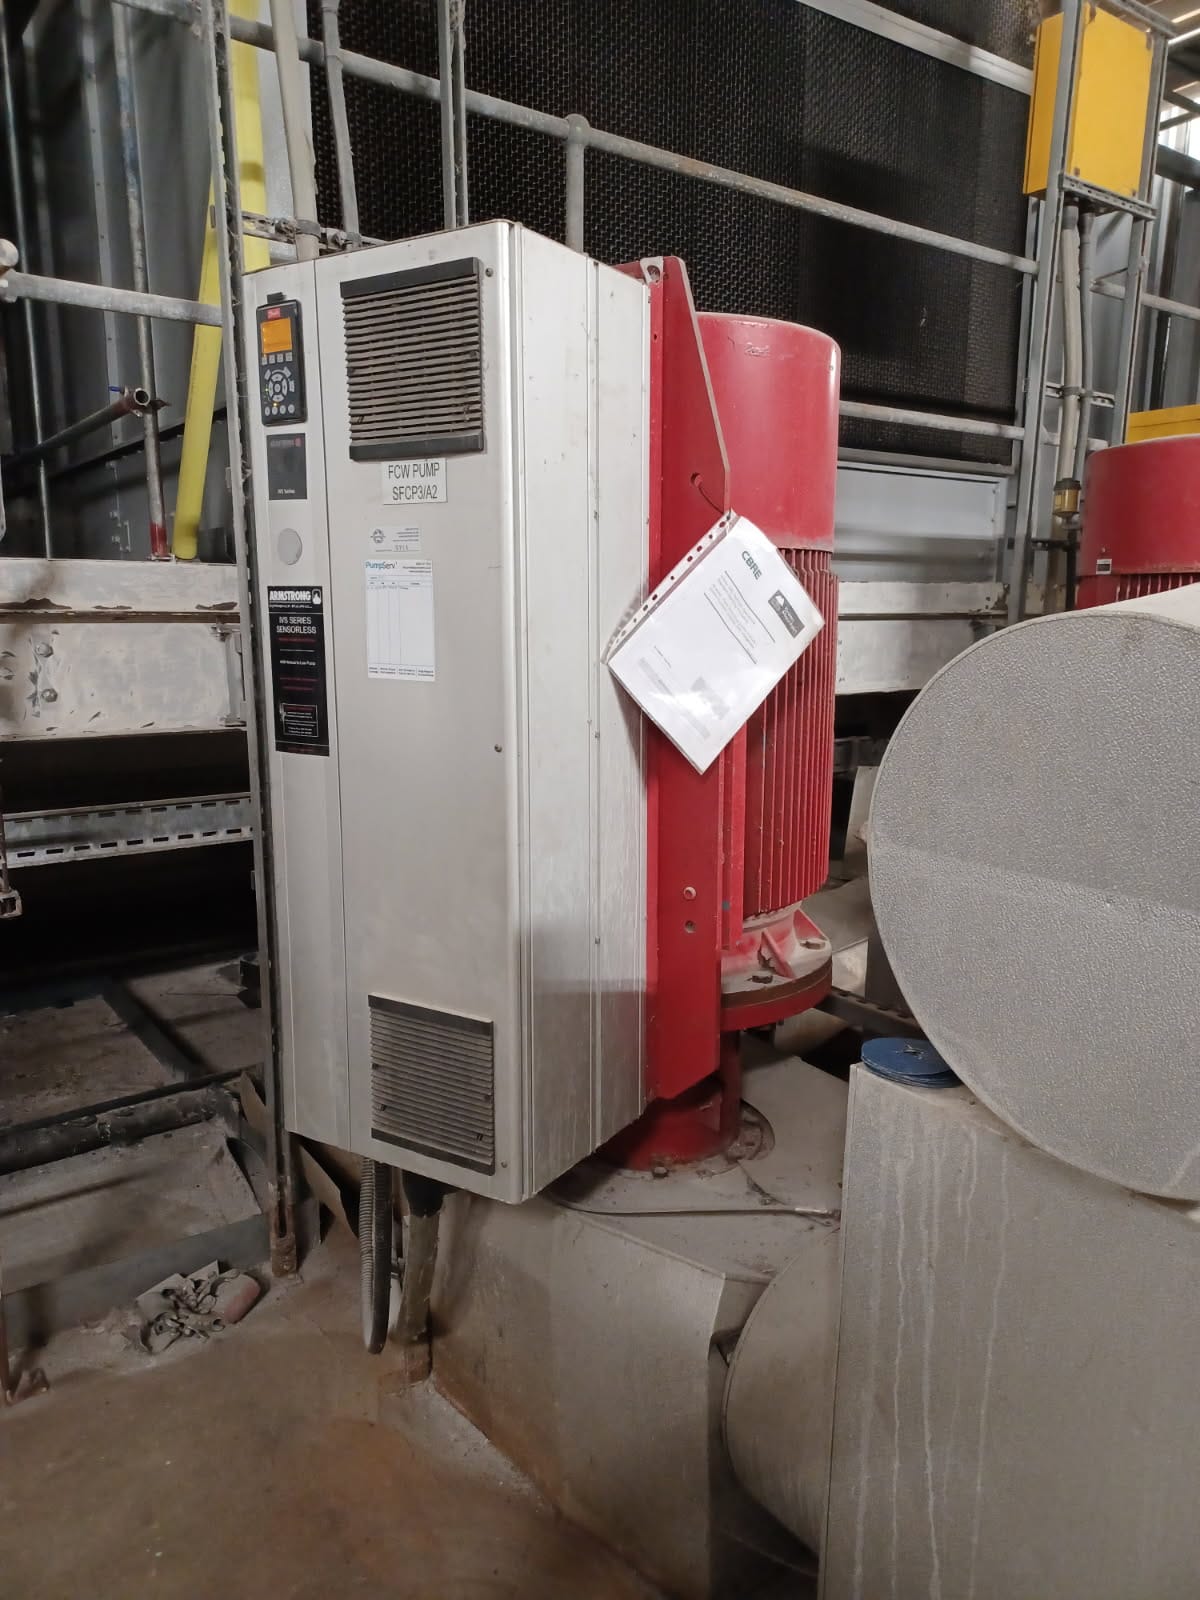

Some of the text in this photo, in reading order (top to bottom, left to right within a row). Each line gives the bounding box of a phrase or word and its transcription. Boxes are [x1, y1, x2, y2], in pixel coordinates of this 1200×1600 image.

[388, 462, 440, 480] FCW PUMP
[392, 485, 438, 501] SFCP3/A2
[365, 561, 396, 570] PumpServ
[741, 550, 763, 580] CBRE
[269, 590, 312, 601] ARMSTRONG
[289, 616, 312, 625] SERIES
[276, 625, 317, 634] SENSORLESS
